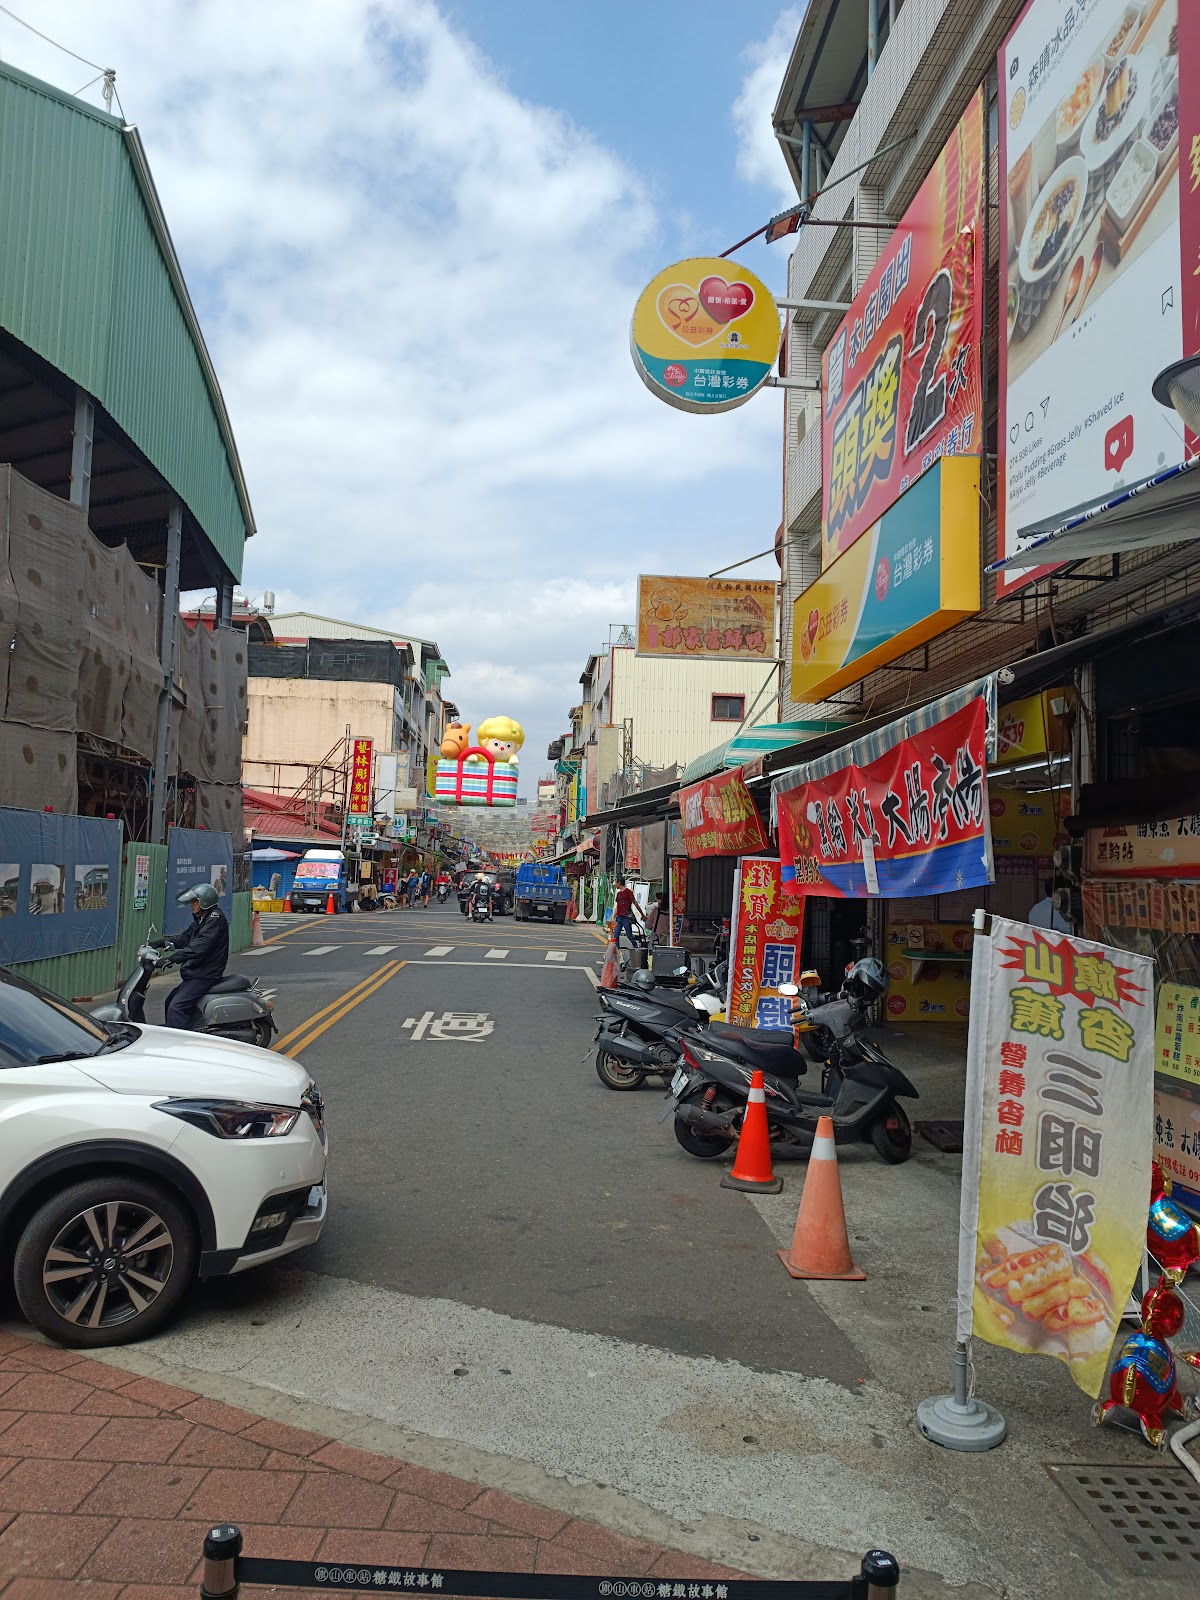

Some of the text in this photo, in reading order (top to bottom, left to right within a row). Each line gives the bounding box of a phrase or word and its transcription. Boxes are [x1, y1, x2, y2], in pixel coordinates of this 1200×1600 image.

[848, 232, 913, 369] 本店開出
[681, 326, 713, 335] 公益彩券
[694, 374, 749, 389] 台灣彩券
[826, 326, 847, 421] 賀
[827, 338, 903, 535] 頭獎
[1009, 392, 1125, 487] #Tofu Pudding #Grass Jelly #Shaved Ice
[1028, 437, 1043, 455] Likes
[1024, 473, 1037, 490] Jelly
[1037, 453, 1067, 480] #Beverage
[893, 537, 934, 588] 台灣彩券
[818, 599, 849, 641] 公益彩券
[401, 1011, 495, 1042] 慢
[1184, 1066, 1191, 1074] 50
[1154, 1114, 1175, 1149] 東煮
